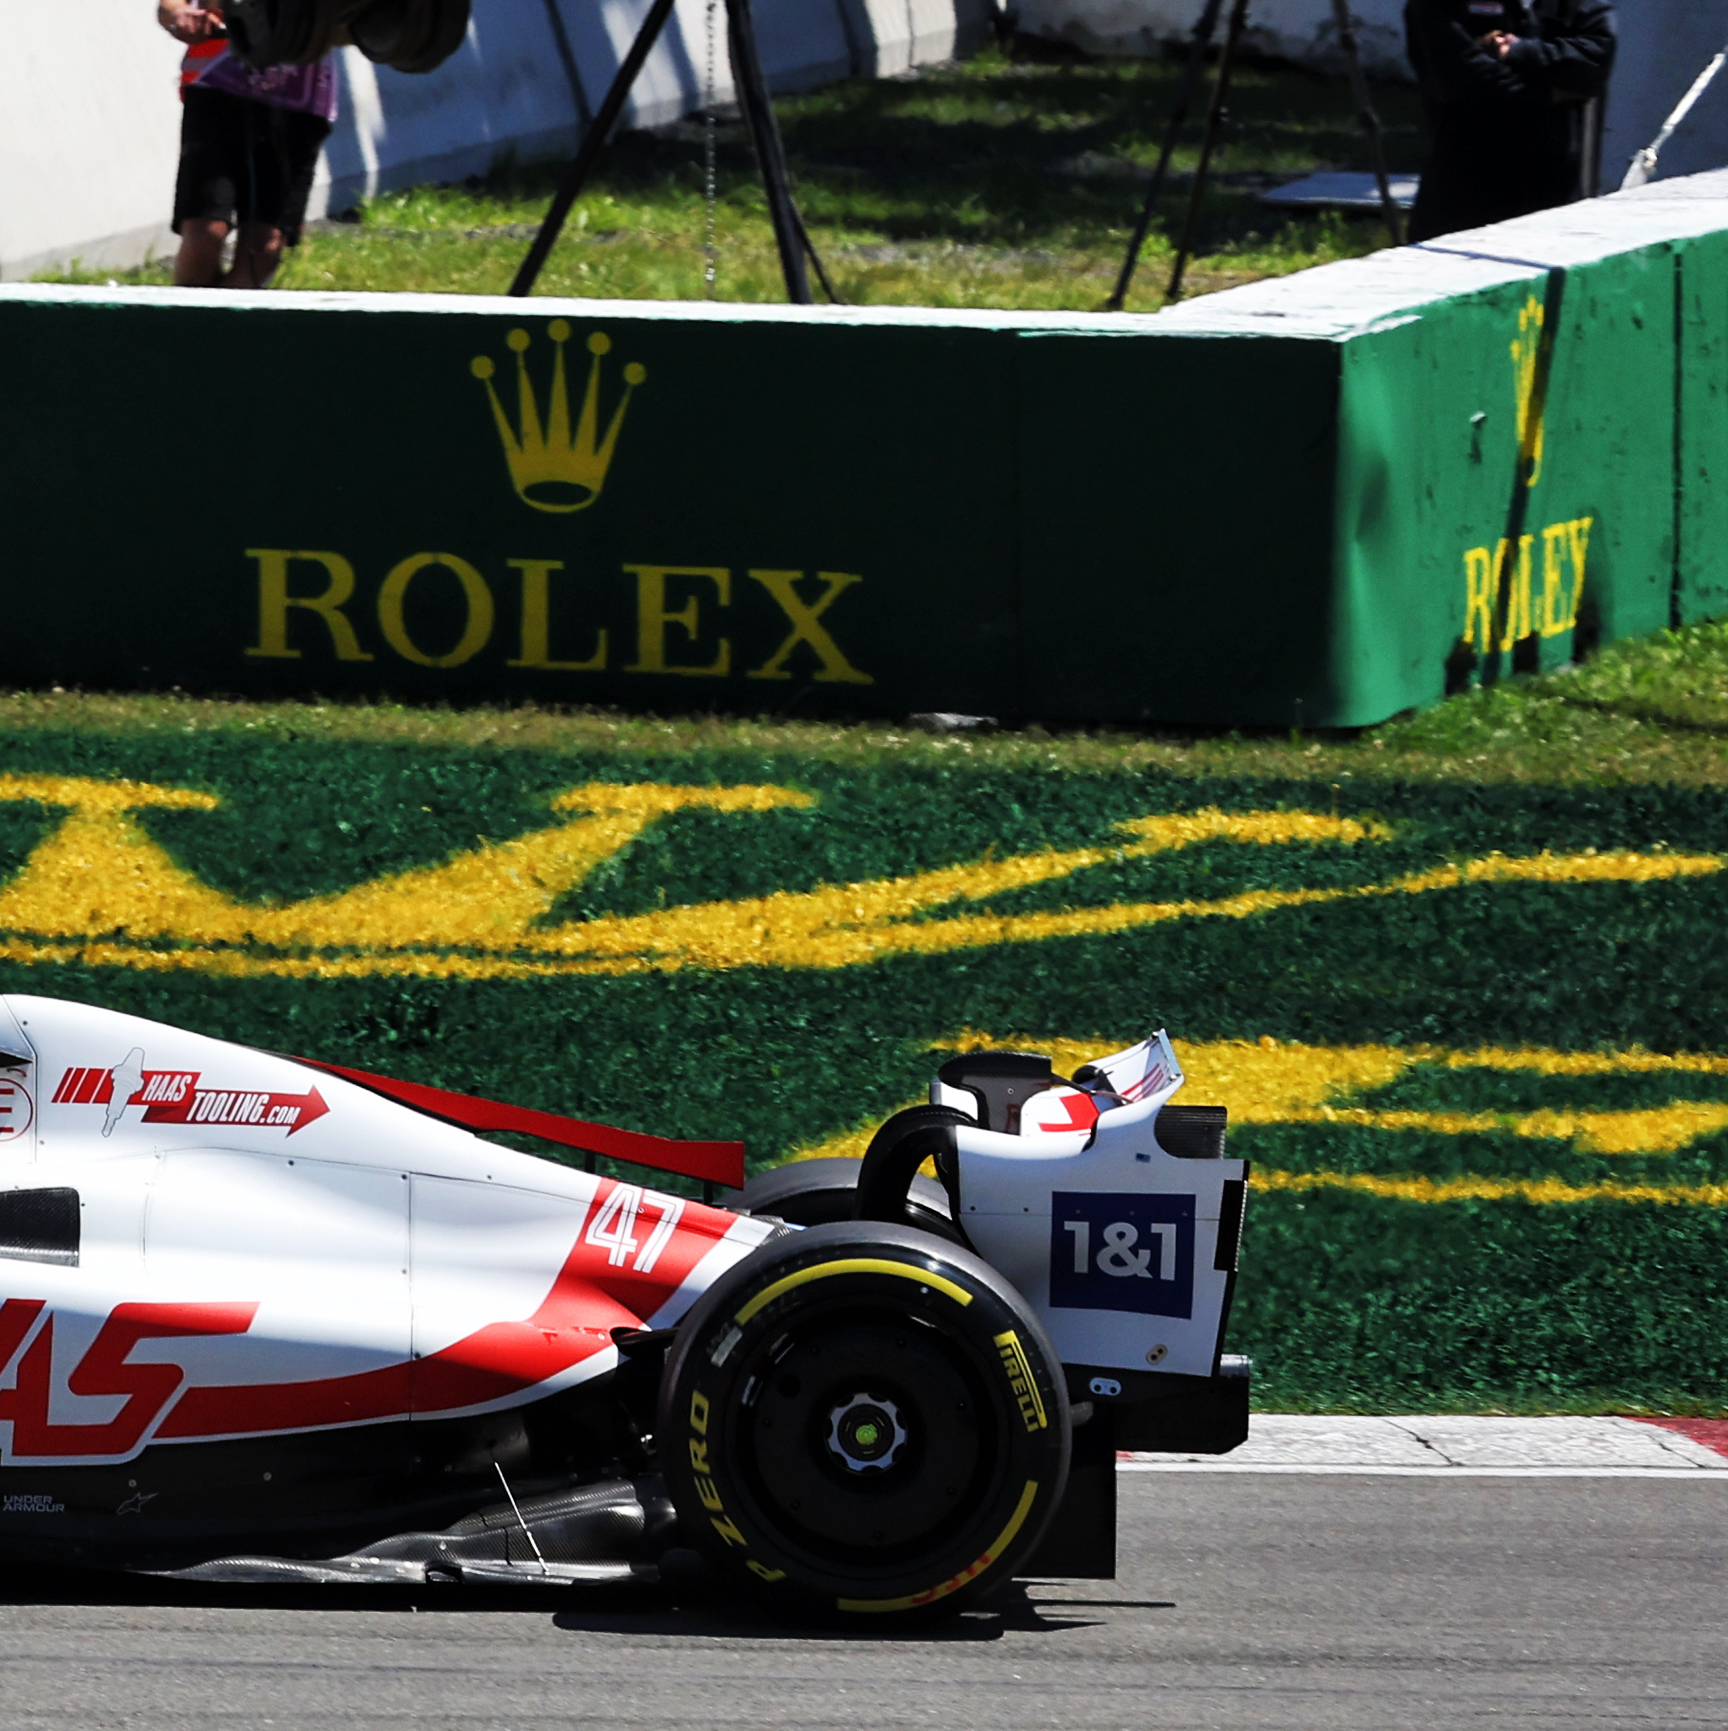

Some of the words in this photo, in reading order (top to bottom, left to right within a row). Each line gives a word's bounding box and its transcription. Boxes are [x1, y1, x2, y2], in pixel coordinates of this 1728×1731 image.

[244, 547, 875, 685] ROLEX
[142, 1074, 192, 1102] HAAS
[585, 1181, 686, 1274] 47
[1063, 1220, 1176, 1281] 1&1
[994, 1329, 1047, 1432] PIRELLI
[3, 1495, 52, 1504] UNDER
[689, 1390, 747, 1547] ZERO
[3, 1503, 65, 1512] ARMOUR
